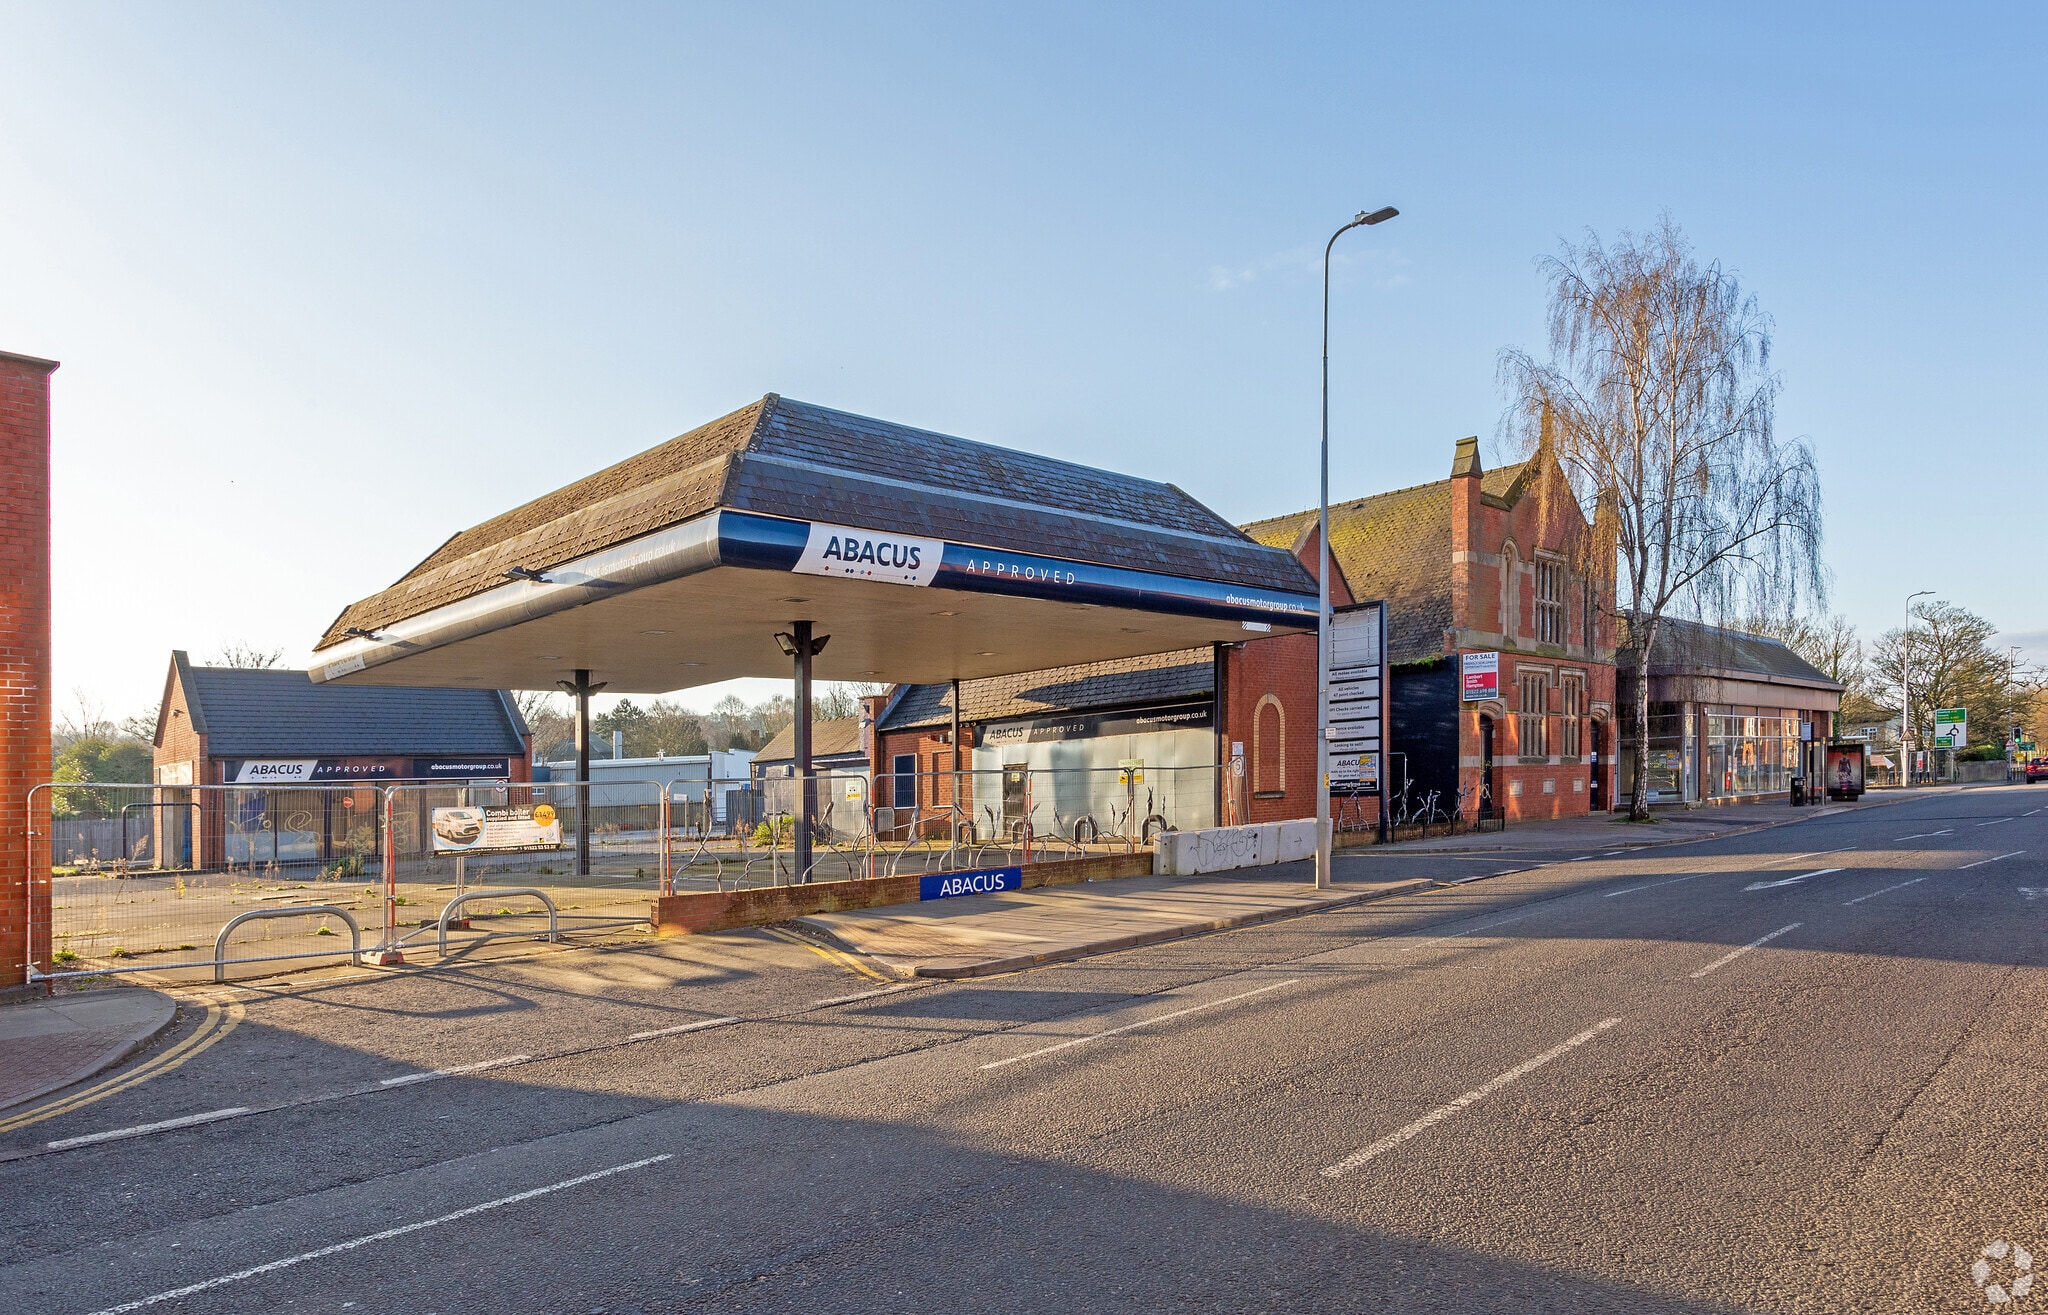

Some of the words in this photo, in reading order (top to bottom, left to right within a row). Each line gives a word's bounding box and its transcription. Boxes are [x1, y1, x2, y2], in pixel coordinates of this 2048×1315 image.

[822, 535, 921, 570] ABACUS
[966, 559, 1075, 585] APPROVED
[1226, 593, 1305, 613] abacusmotorgroup.co.uk
[990, 727, 1023, 739] ABACUS
[1033, 723, 1085, 736] APPROVED
[1135, 709, 1208, 725] abacusmotorgroup.co.uk
[250, 764, 302, 775] ABACUS
[317, 765, 386, 774] APPROVED
[431, 762, 502, 772] abacusmotorgroup.co.uk
[1337, 759, 1360, 767] ABACU
[486, 809, 508, 817] Combi
[510, 808, 530, 816] boiler
